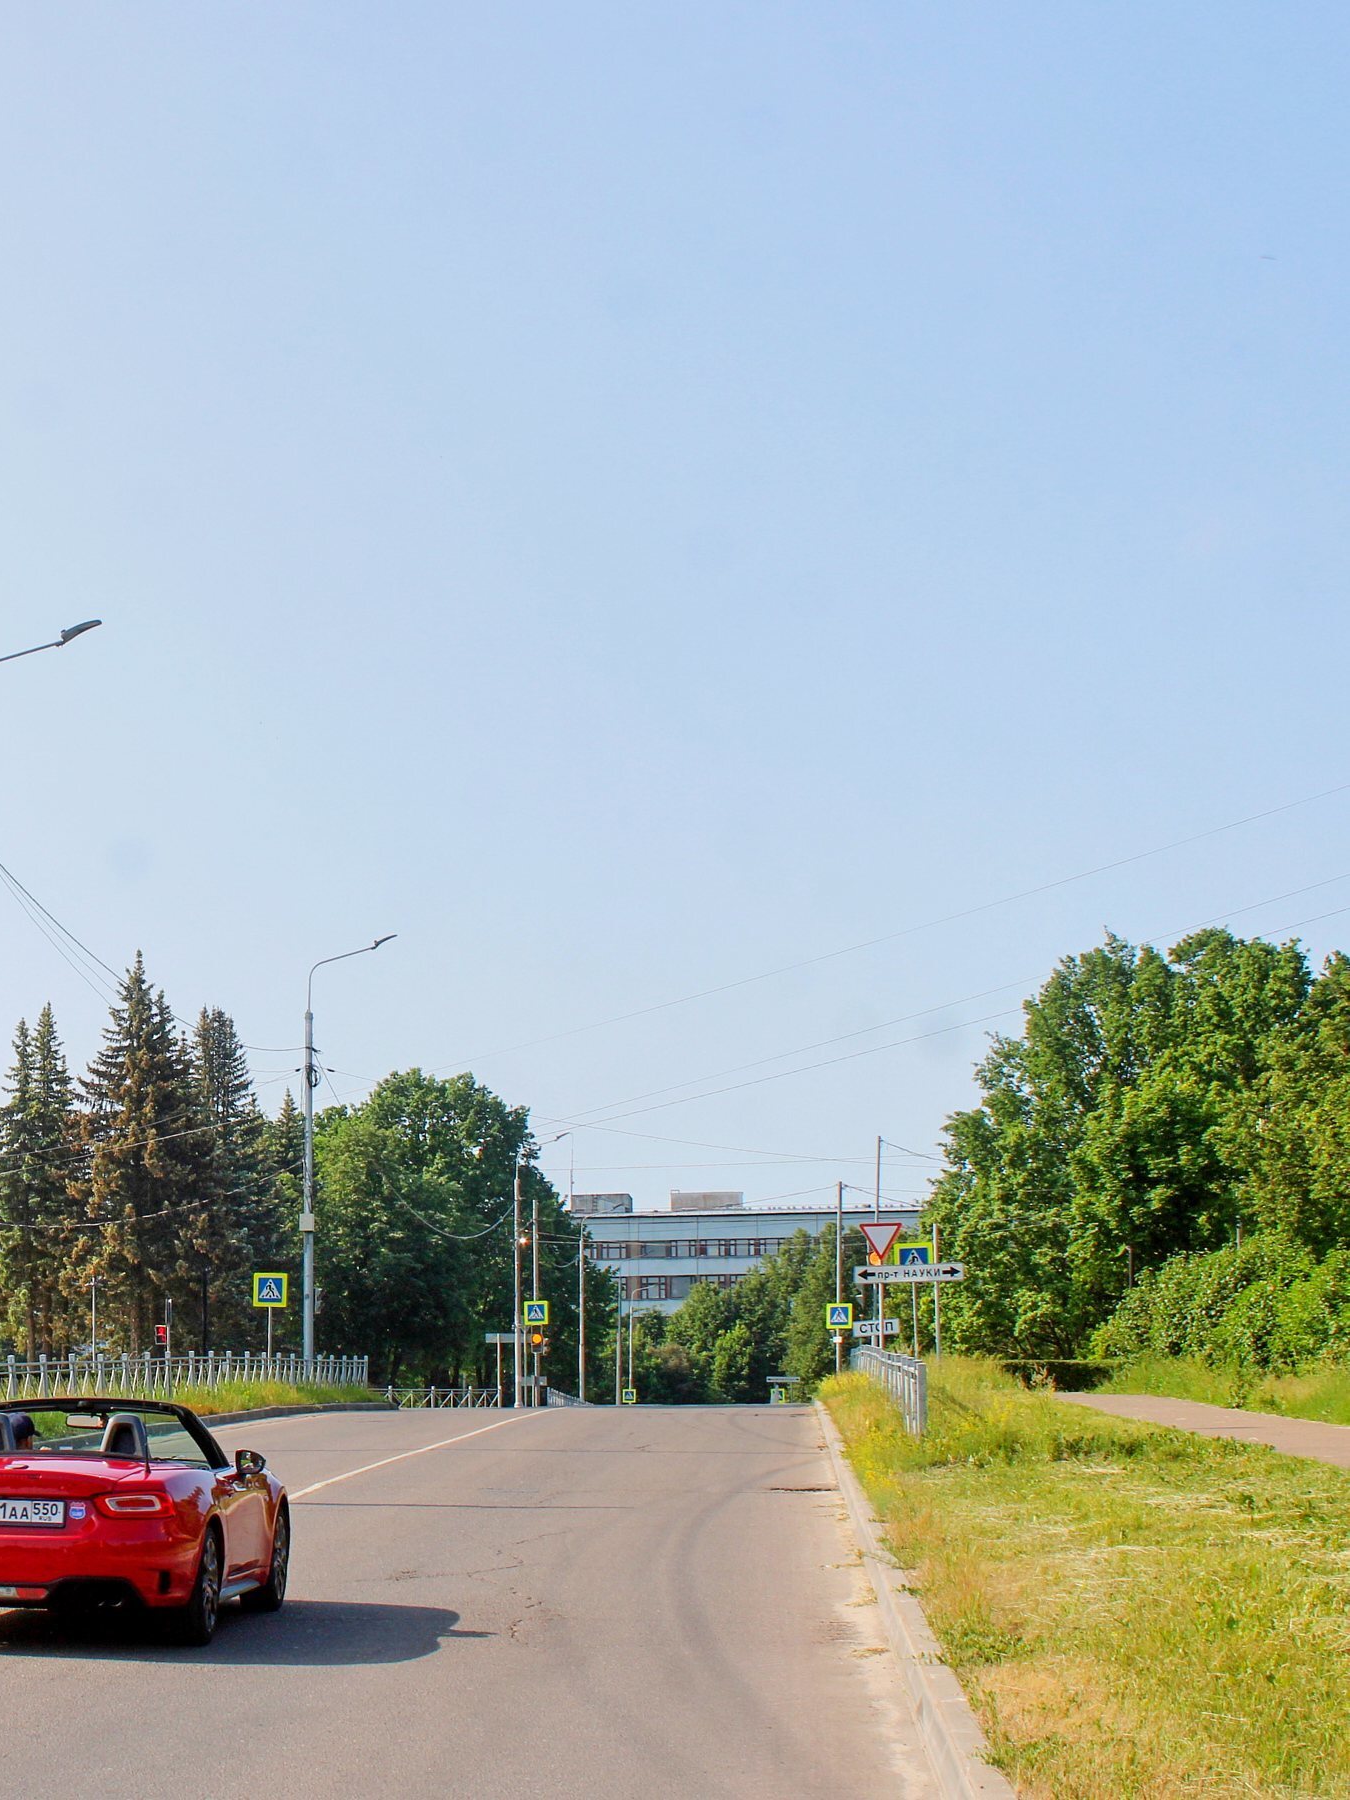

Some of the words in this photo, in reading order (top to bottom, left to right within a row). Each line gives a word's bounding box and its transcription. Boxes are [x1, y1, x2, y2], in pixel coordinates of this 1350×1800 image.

[877, 1270, 899, 1281] пр-т
[903, 1268, 941, 1278] НАУКИ
[32, 1503, 59, 1516] 550
